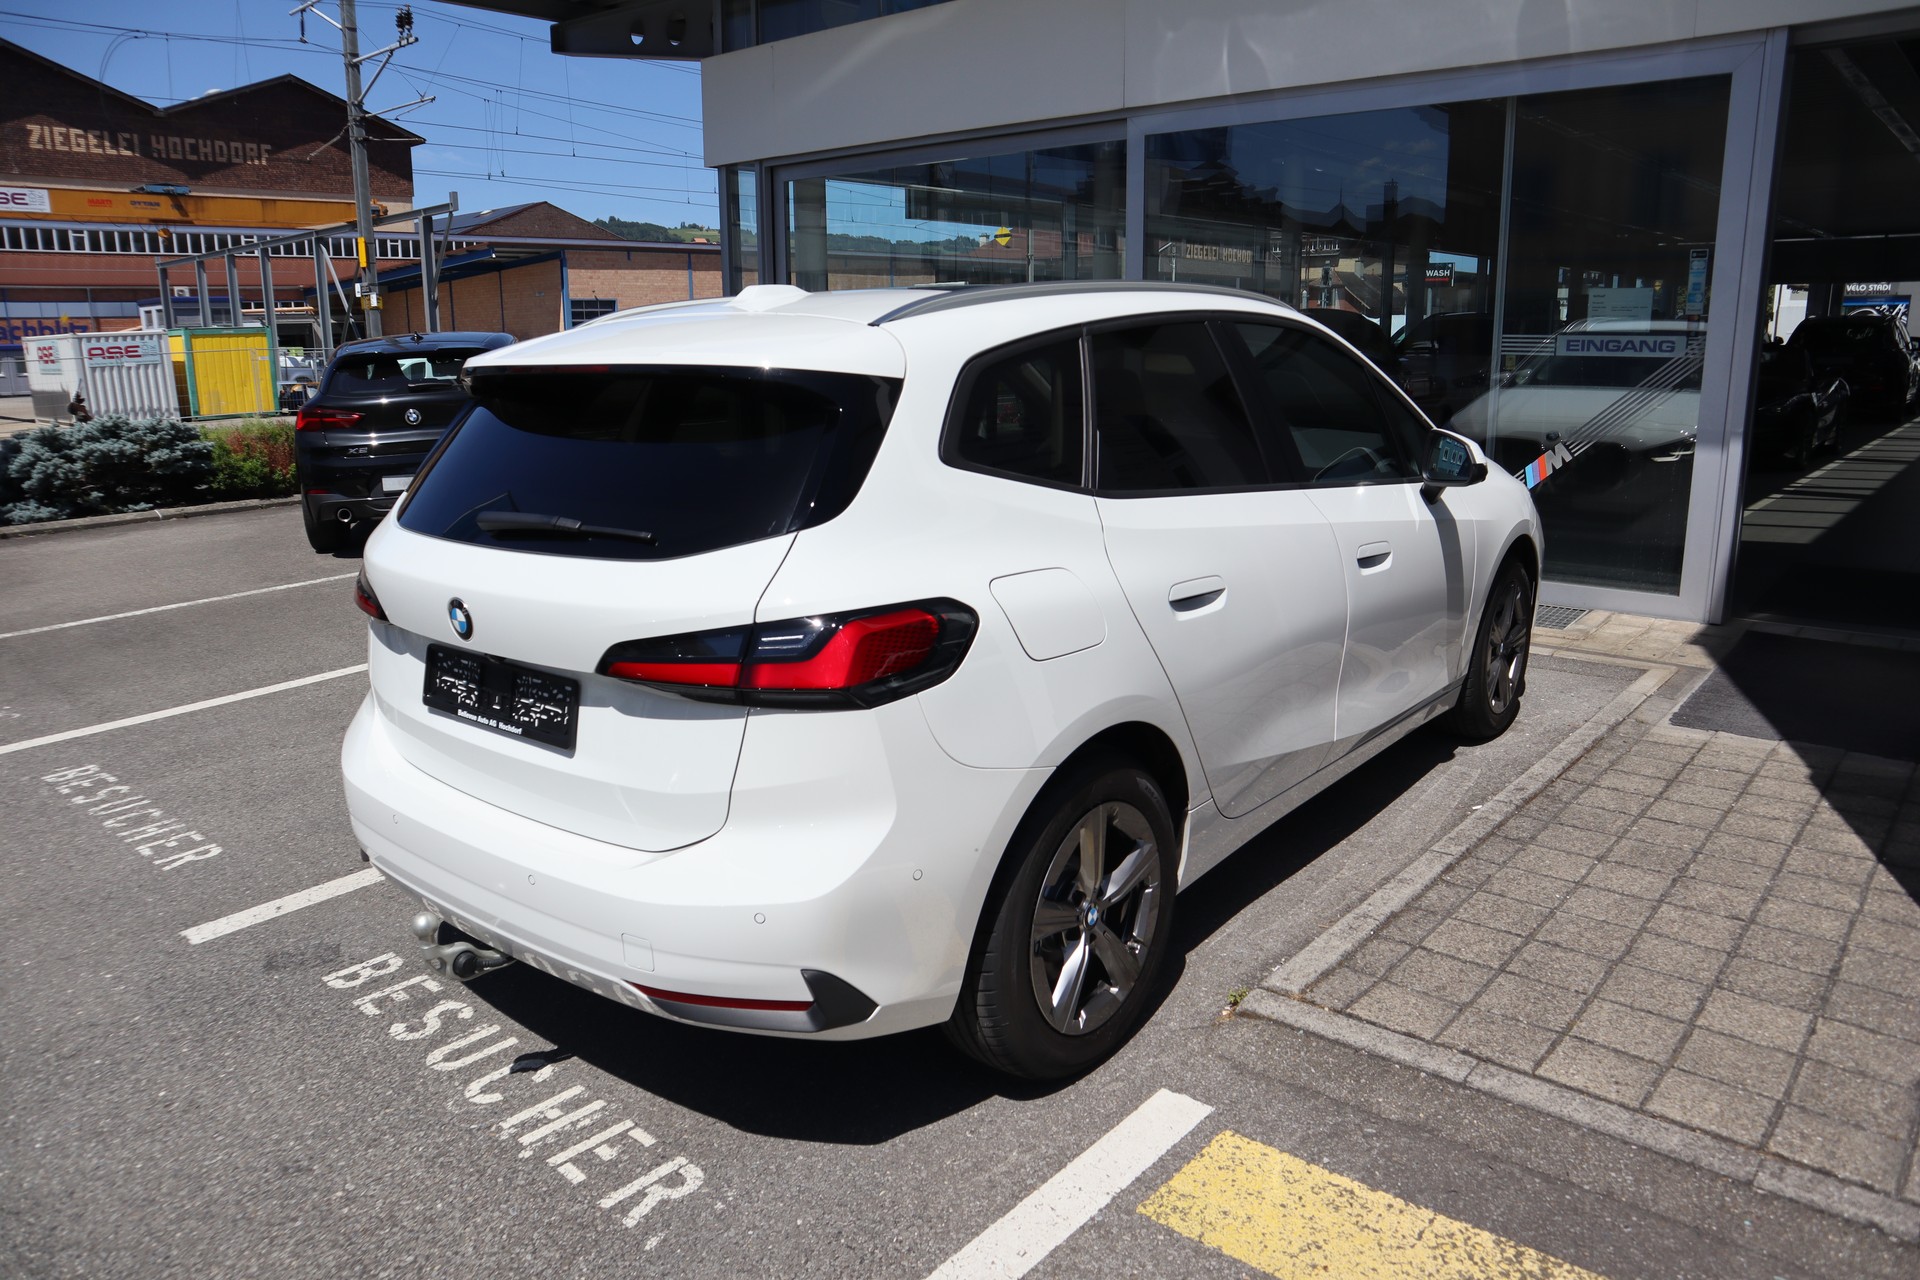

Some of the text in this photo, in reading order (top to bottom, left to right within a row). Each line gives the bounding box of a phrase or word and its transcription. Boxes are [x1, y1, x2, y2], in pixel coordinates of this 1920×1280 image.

[26, 124, 272, 166] ZIEGELEI HOCHDORF
[1425, 269, 1450, 277] WASH
[1846, 284, 1867, 292] VELO
[87, 345, 141, 360] ASE
[1565, 339, 1677, 353] EINGANG
[477, 715, 488, 724] Auto
[489, 719, 497, 727] AG
[498, 721, 522, 734] Hochdorf
[40, 764, 223, 871] BESUCHER
[321, 951, 705, 1229] BESUCHER
